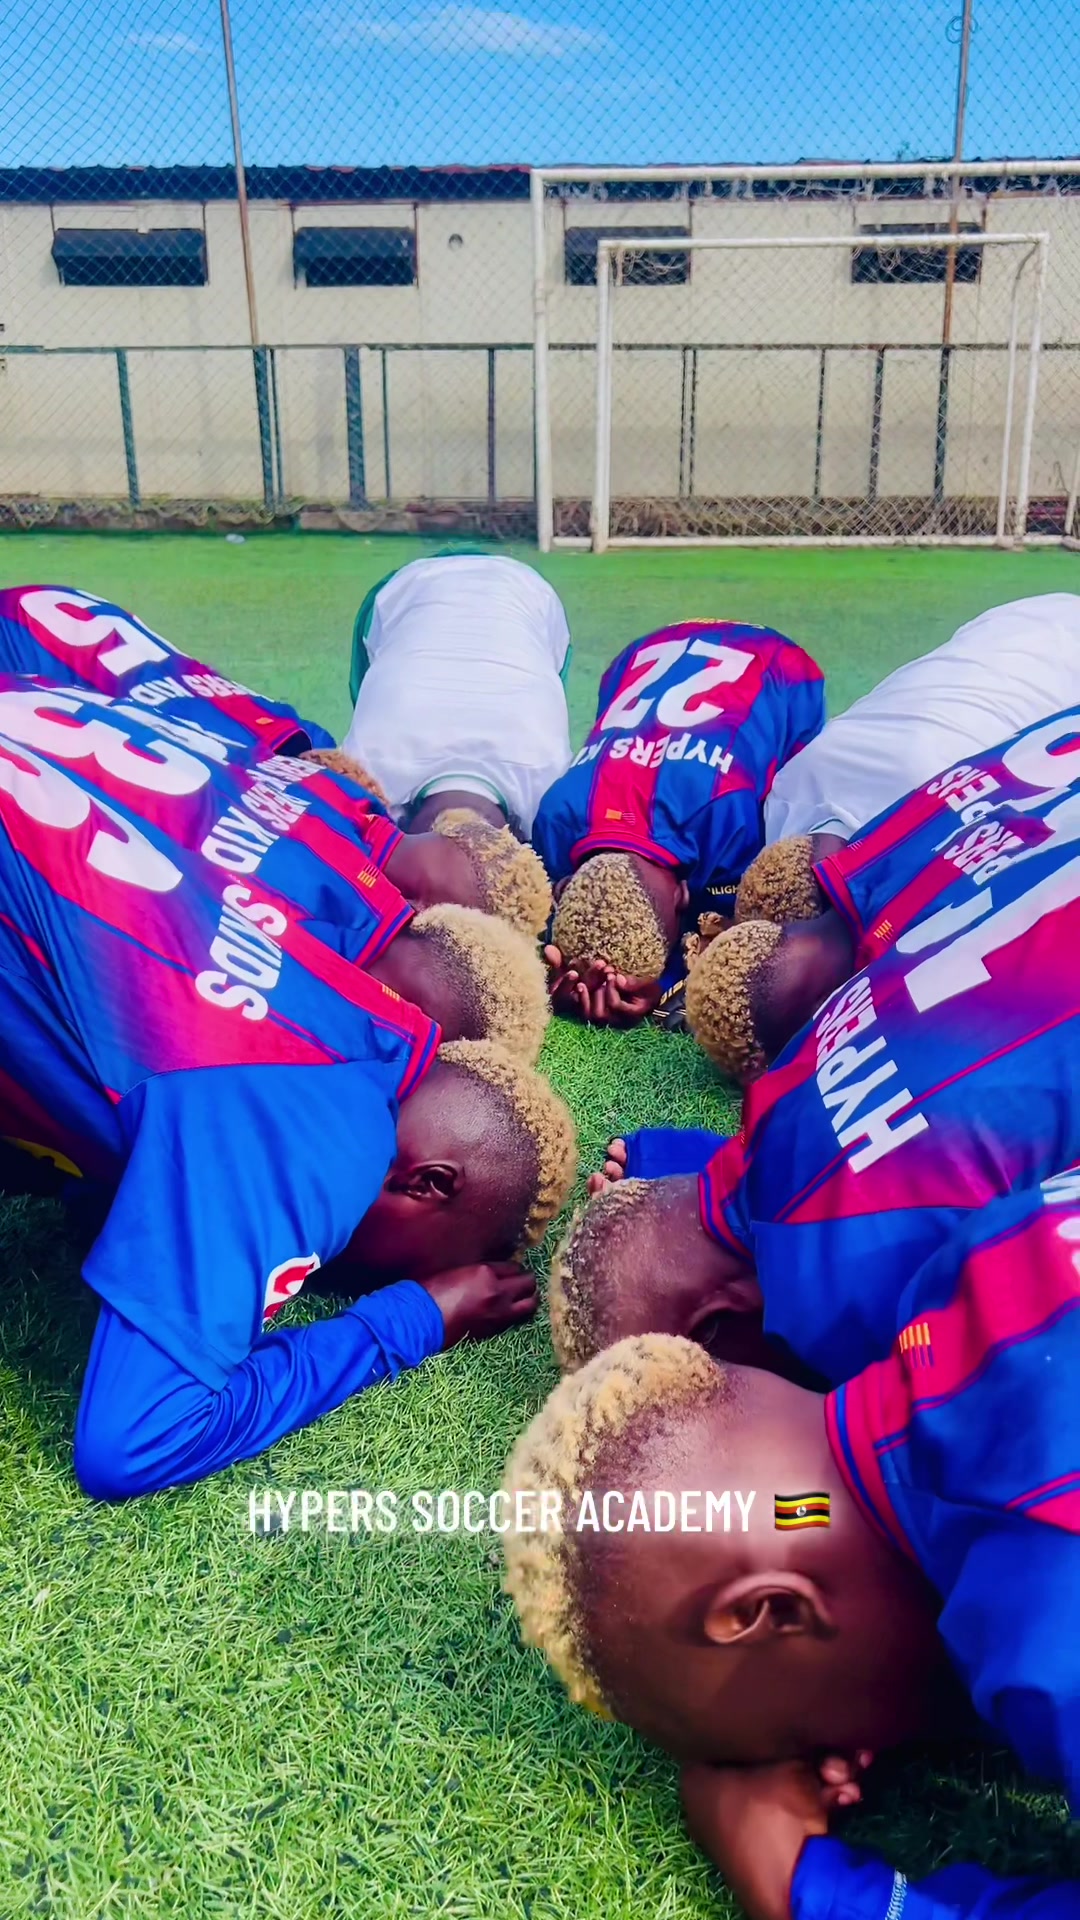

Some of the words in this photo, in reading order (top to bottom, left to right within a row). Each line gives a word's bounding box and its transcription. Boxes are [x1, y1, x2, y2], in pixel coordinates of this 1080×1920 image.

[600, 637, 755, 731] 22
[610, 732, 734, 774] HYPERS
[815, 976, 930, 1174] HYPERS
